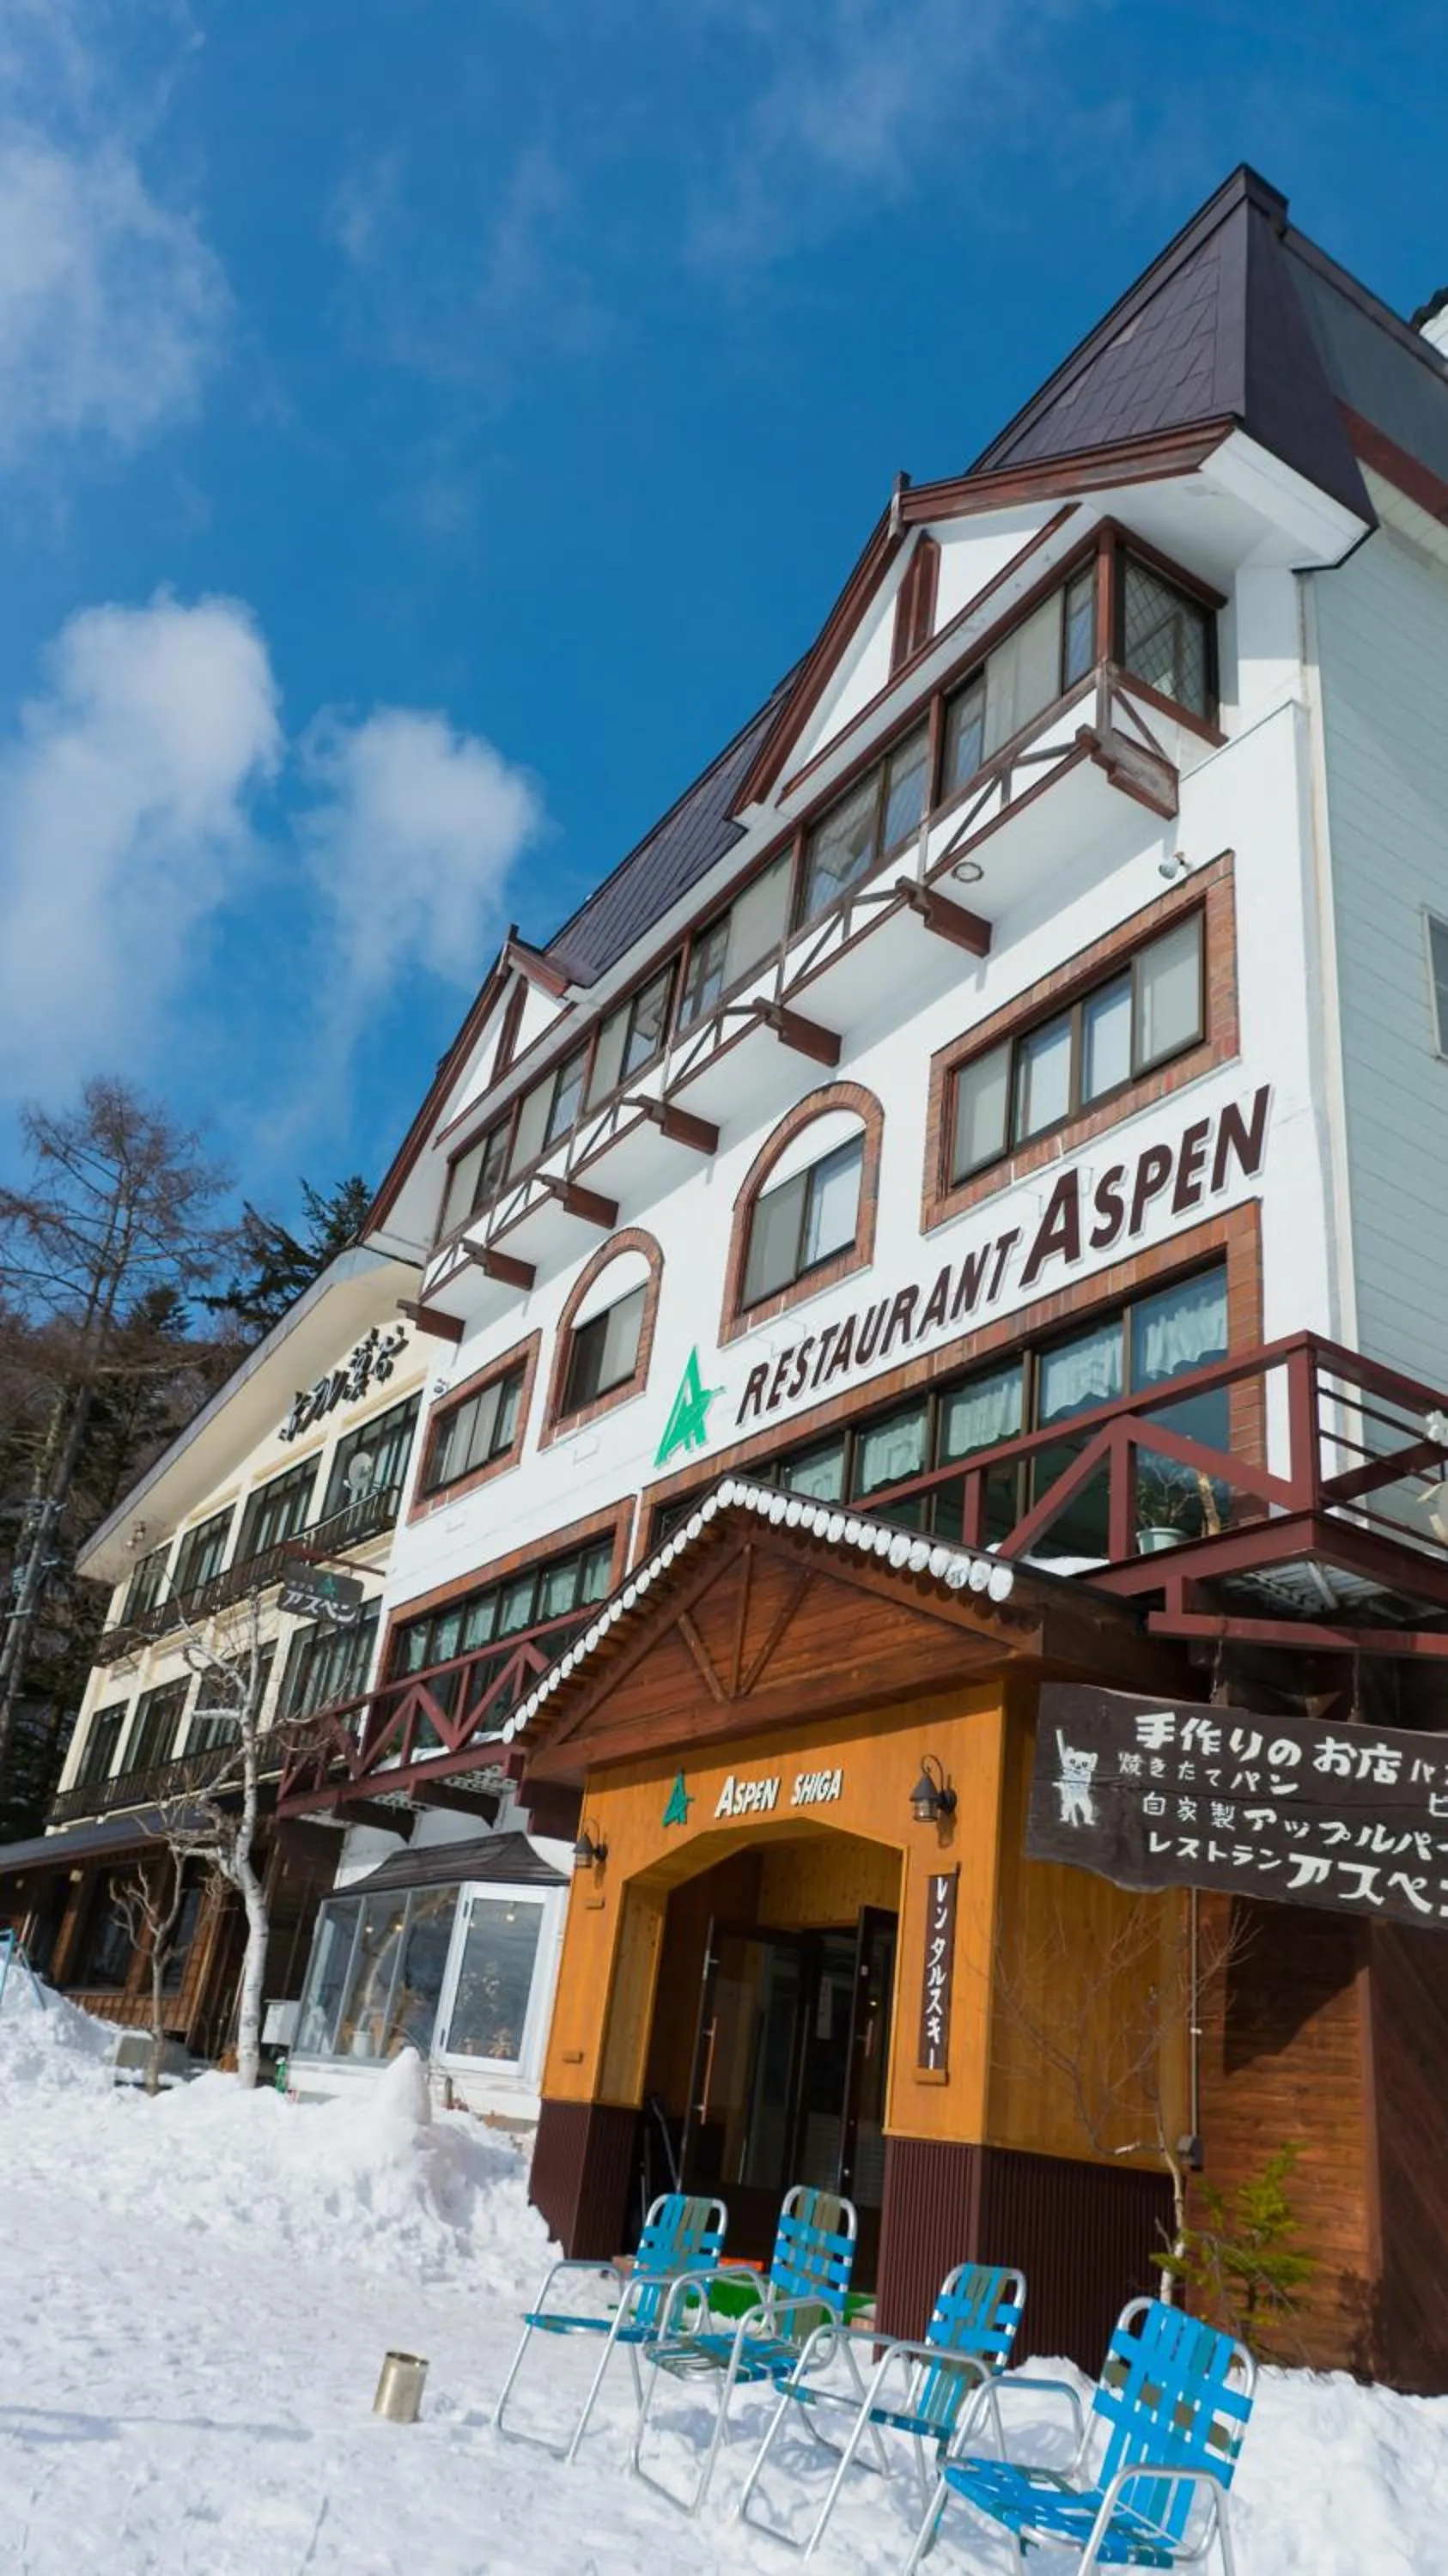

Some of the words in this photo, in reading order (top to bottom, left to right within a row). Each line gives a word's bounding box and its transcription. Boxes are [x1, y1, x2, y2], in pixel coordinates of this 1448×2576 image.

[735, 1228, 1021, 1426] RESTAURANT
[1019, 1084, 1272, 1289] ASPEN
[1118, 1751, 1299, 1795] 焼きたてパン
[1135, 1711, 1403, 1785] 手作りのお店
[715, 1775, 781, 1820] ASPEN
[791, 1768, 843, 1807] SHIGA
[927, 1876, 949, 2070] レンタルスキー
